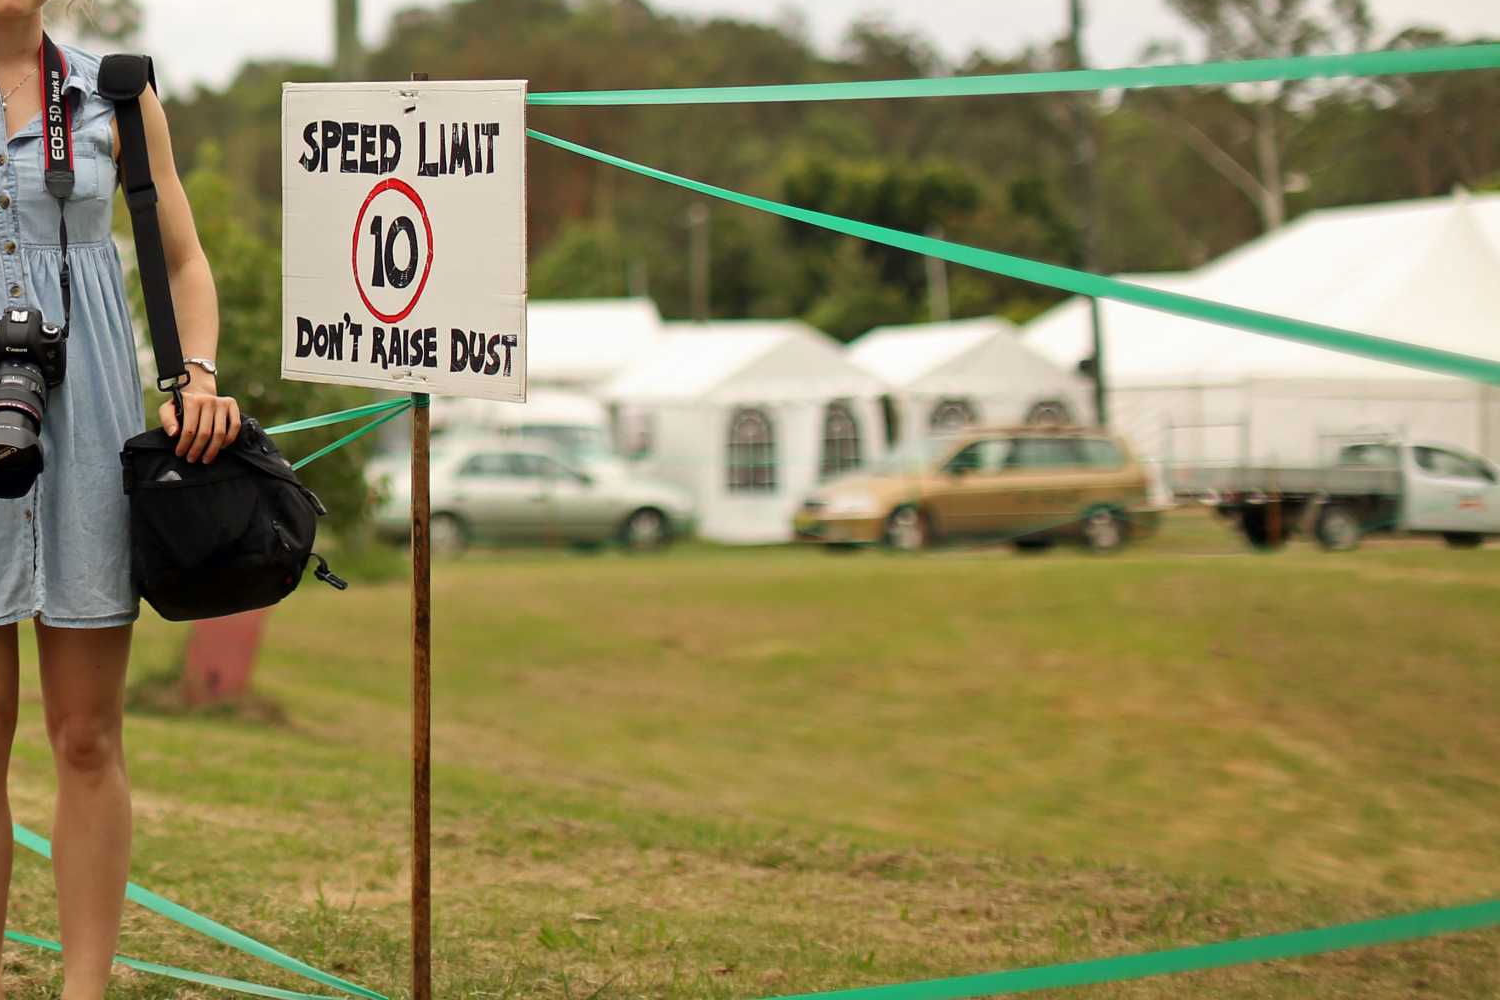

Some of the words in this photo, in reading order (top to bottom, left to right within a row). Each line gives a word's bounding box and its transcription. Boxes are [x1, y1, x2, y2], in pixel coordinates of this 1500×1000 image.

[49, 104, 62, 122] 5D
[51, 80, 60, 103] Mark
[51, 126, 65, 160] EOS
[298, 120, 401, 175] SPEED
[417, 121, 500, 177] LIMIT
[370, 215, 419, 289] 10
[295, 312, 363, 362] DON'T
[370, 326, 438, 369] RAISE
[450, 327, 518, 377] DUST
